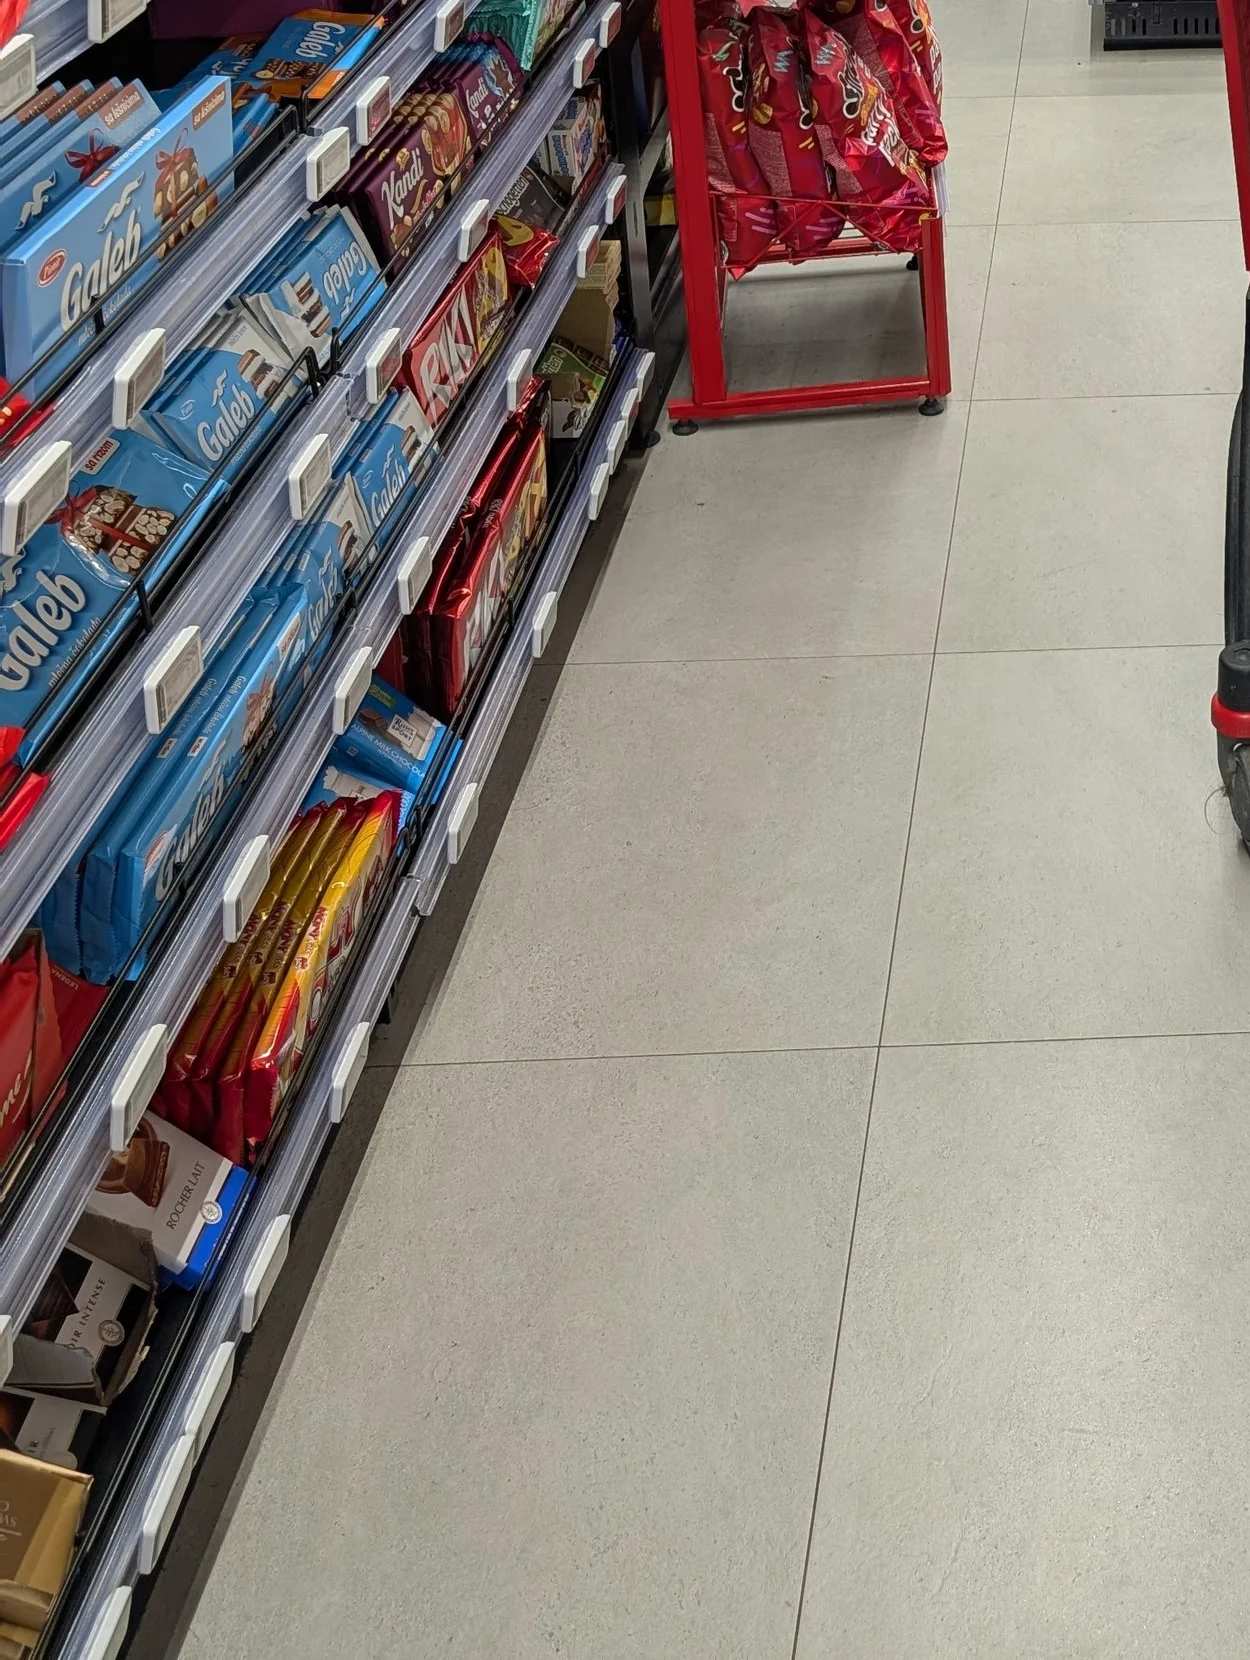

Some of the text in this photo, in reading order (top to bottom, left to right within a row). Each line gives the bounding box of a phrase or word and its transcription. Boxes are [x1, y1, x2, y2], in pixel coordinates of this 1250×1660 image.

[292, 21, 346, 61] Galeb
[113, 89, 142, 118] lešnicima
[381, 148, 425, 229] Kandi
[60, 210, 142, 333] Galeb
[197, 389, 257, 463] Galeb
[84, 438, 116, 472] sa rizom
[350, 723, 426, 778] ALPINE MILK CHOCOLA
[166, 1161, 205, 1230] ROCHER LAIT
[80, 1277, 108, 1330] INTENSE
